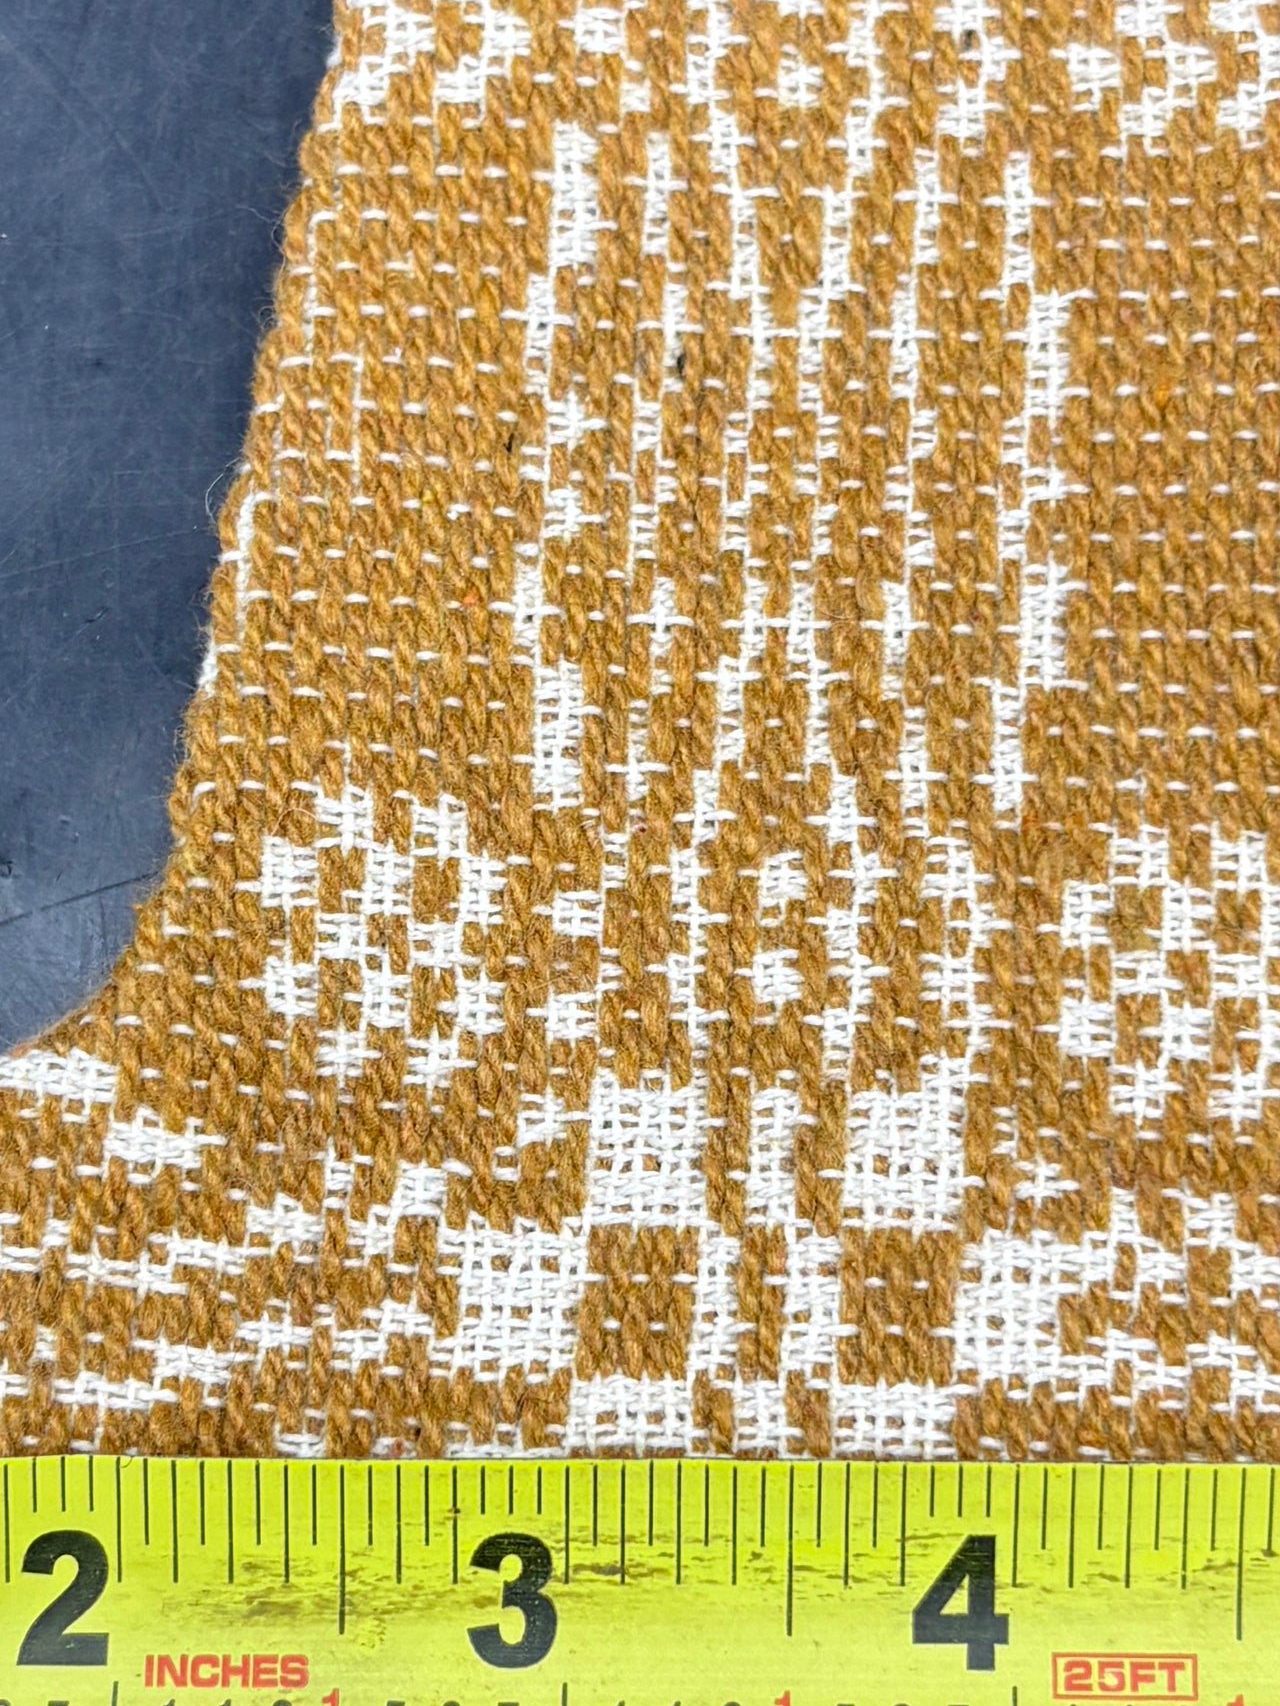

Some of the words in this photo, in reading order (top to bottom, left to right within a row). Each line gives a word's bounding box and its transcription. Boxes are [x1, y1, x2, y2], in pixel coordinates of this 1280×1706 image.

[16, 1530, 109, 1666] 2
[468, 1532, 558, 1668] 3
[912, 1534, 1009, 1671] 4
[144, 1653, 309, 1689] INCHES
[1063, 1659, 1187, 1693] 25FT
